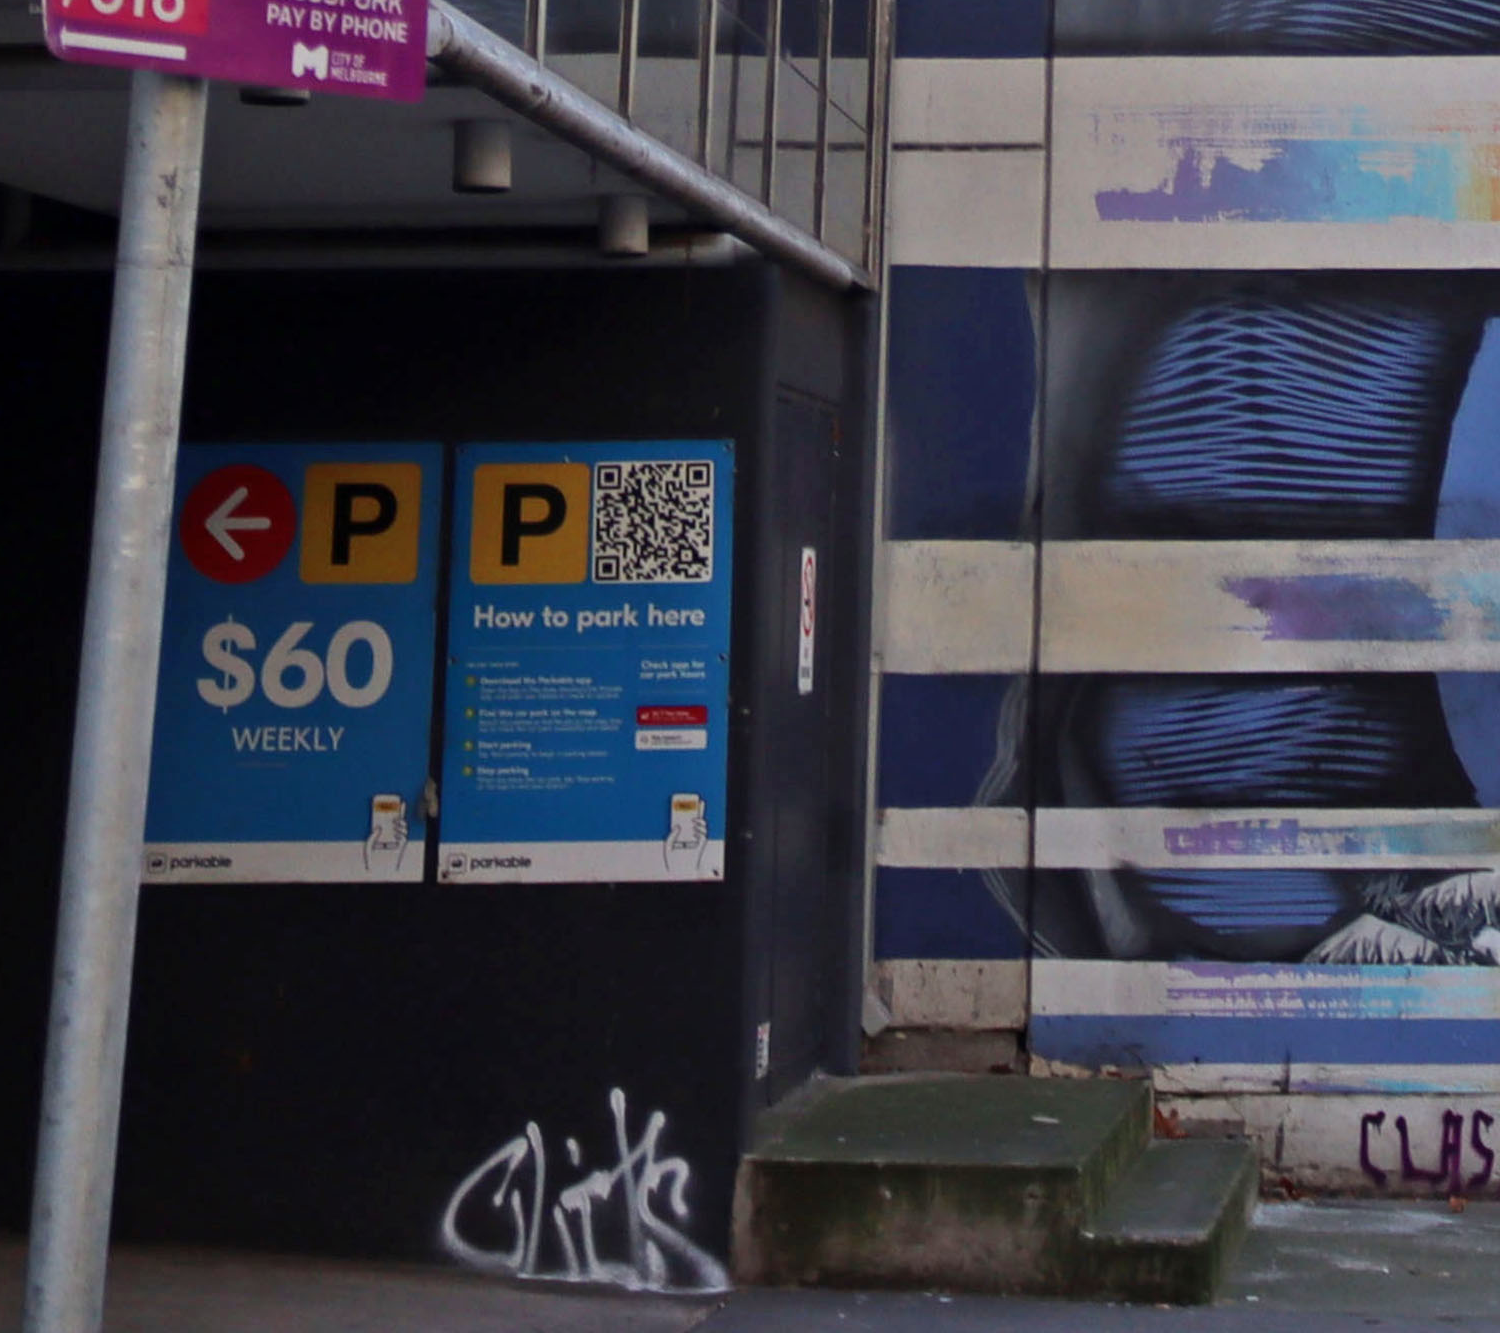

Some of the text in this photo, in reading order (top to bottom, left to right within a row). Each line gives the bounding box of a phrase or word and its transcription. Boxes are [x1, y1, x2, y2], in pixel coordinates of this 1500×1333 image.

[267, 3, 409, 43] PAY BY PHONE
[473, 602, 706, 633] How to park here
[196, 614, 393, 715] $60
[233, 726, 345, 752] WEEKLY
[169, 852, 232, 870] parkable
[469, 852, 532, 870] parkable
